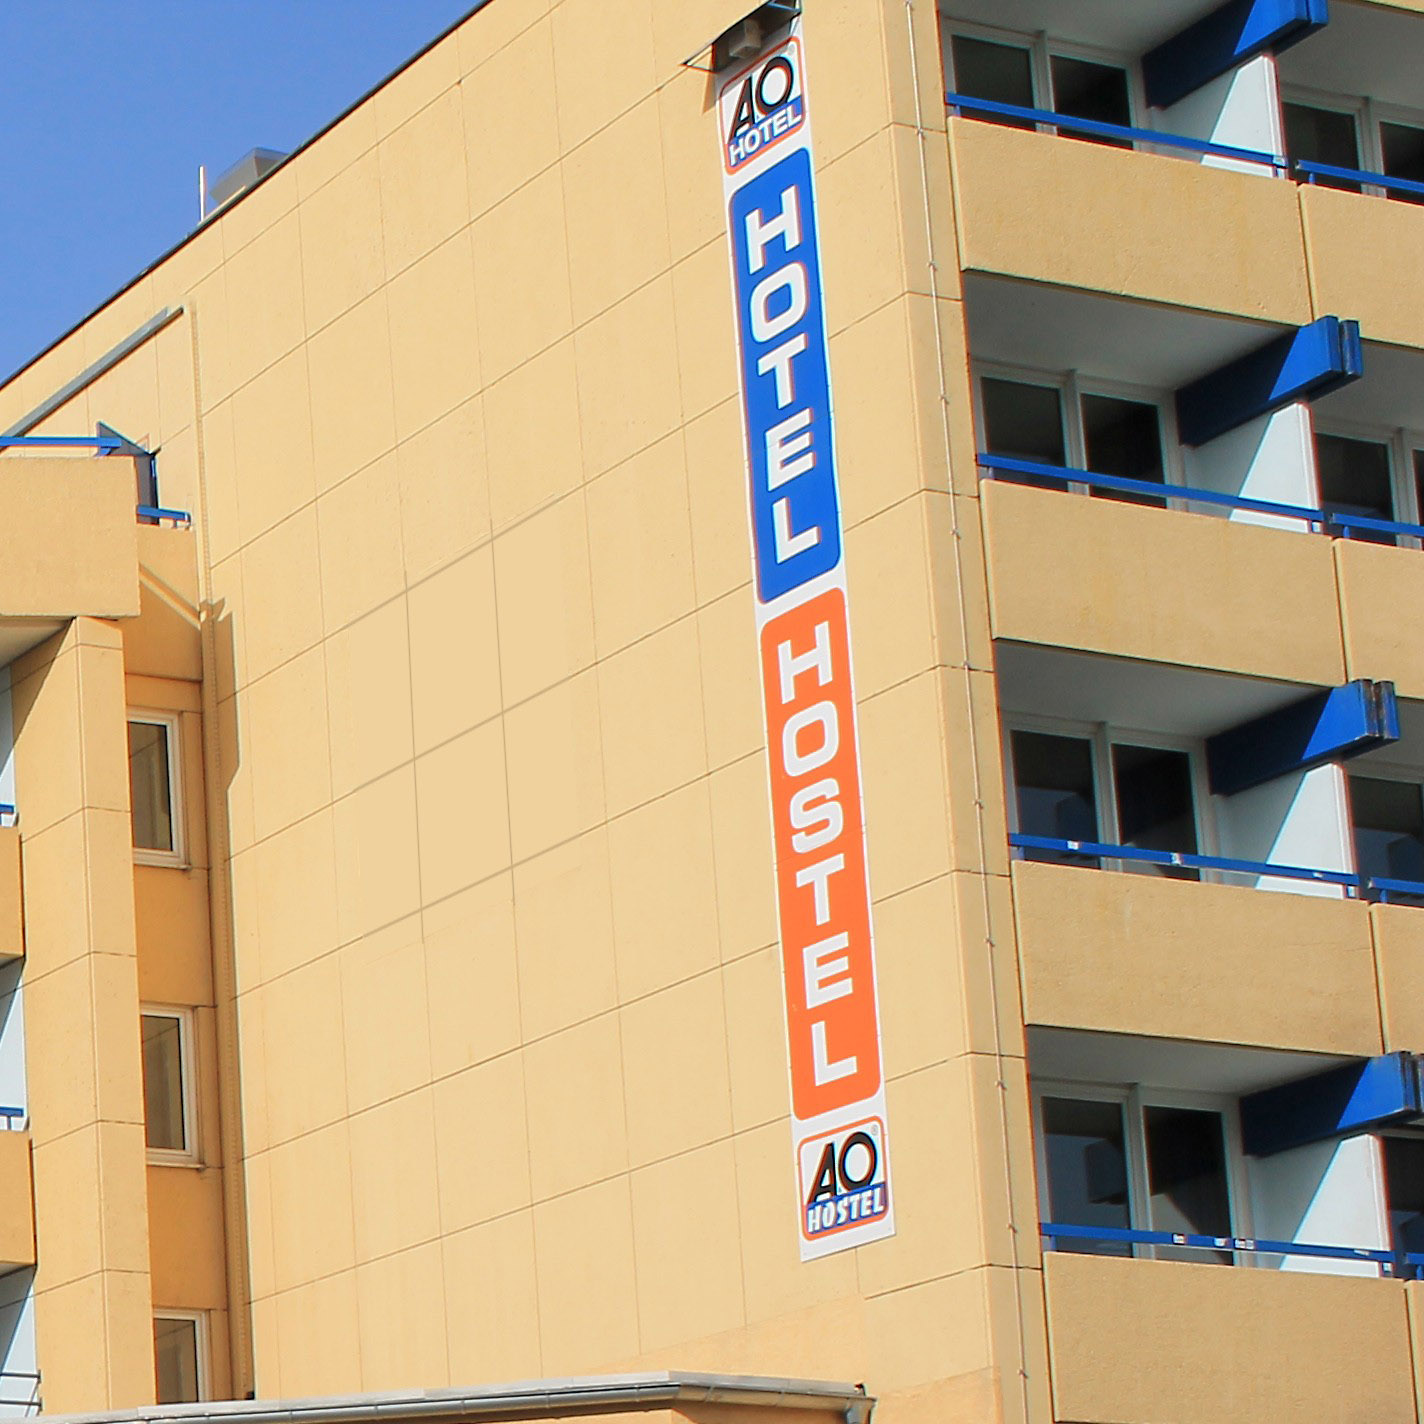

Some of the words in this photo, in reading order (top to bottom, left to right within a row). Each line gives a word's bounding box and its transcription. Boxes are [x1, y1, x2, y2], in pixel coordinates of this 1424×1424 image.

[729, 104, 802, 167] HOTEL
[744, 184, 821, 565] HOTEL
[778, 621, 858, 1088] HOSTEL
[807, 1187, 884, 1233] HOSTEL
